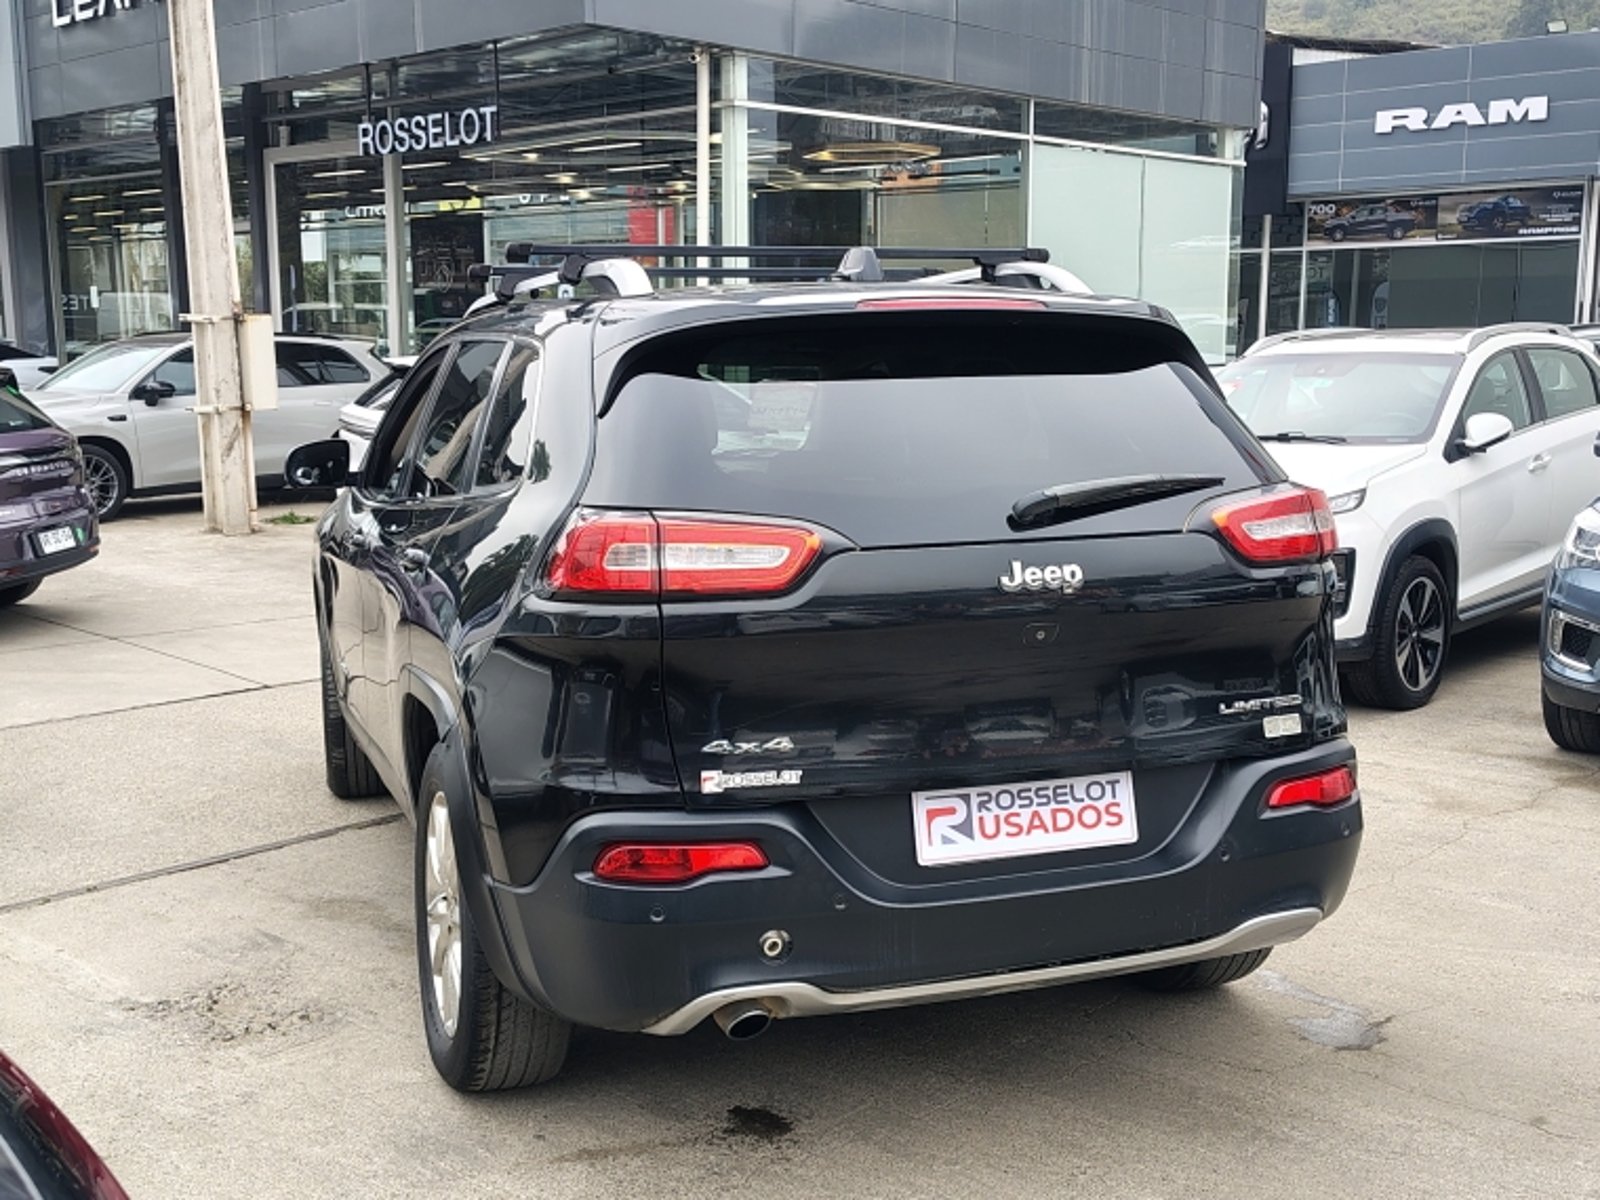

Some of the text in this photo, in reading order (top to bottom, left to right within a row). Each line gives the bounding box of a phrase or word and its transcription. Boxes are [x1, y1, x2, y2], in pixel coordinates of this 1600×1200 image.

[358, 105, 497, 156] ROSSELOT
[1374, 95, 1548, 134] RAM
[999, 560, 1083, 594] Jeep
[721, 771, 802, 787] ROSSELOT
[976, 779, 1120, 812] ROSSELOT
[978, 802, 1123, 840] USADOS
